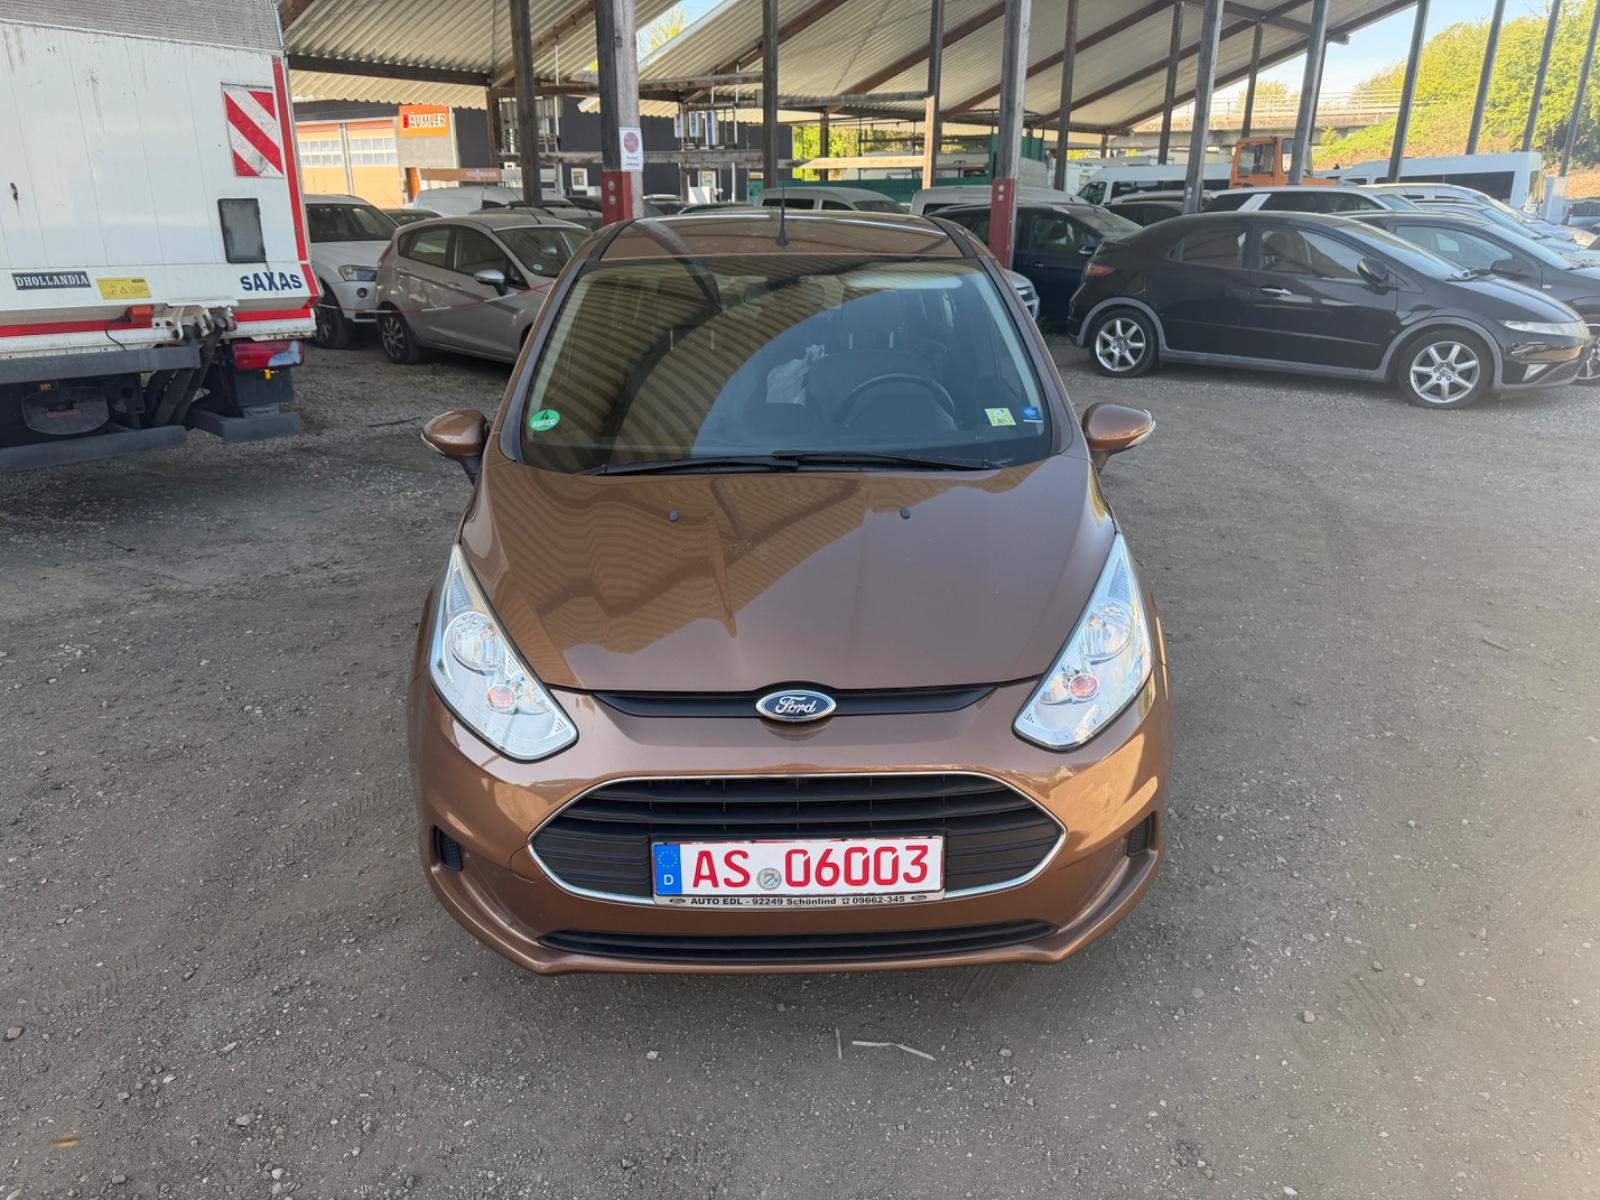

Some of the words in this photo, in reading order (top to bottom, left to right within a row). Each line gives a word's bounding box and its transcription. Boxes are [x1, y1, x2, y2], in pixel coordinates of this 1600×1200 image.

[15, 274, 88, 287] DHOLLANDIA
[240, 272, 302, 291] SAXAS
[775, 696, 816, 714] Ford
[692, 850, 751, 889] AS
[785, 845, 929, 888] 06003
[663, 874, 674, 886] D
[690, 898, 719, 906] AUTO
[722, 898, 743, 906] EDL
[752, 897, 784, 906] 92249
[786, 897, 837, 906] Schönlind
